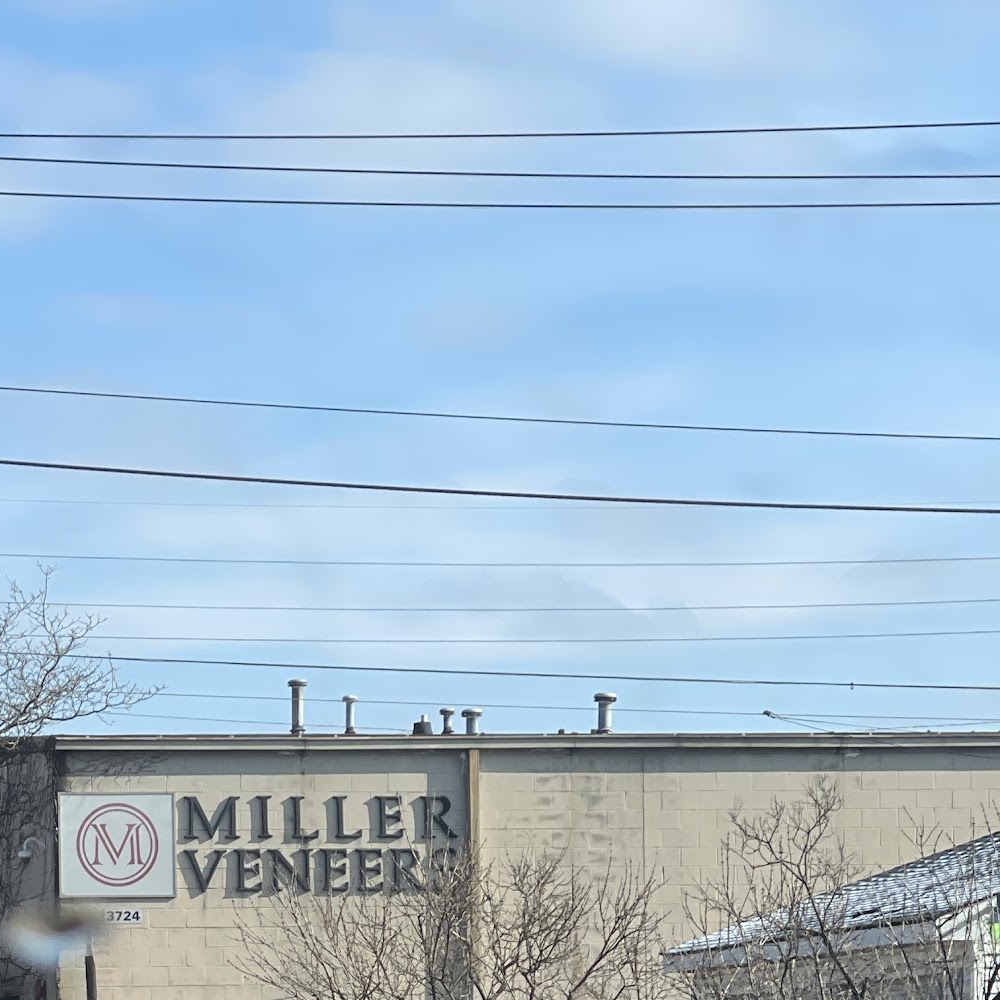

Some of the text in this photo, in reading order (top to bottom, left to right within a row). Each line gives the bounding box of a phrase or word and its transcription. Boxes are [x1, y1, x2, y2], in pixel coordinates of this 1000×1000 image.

[183, 795, 459, 840] MILLER
[90, 823, 146, 866] M
[106, 910, 141, 921] 3724
